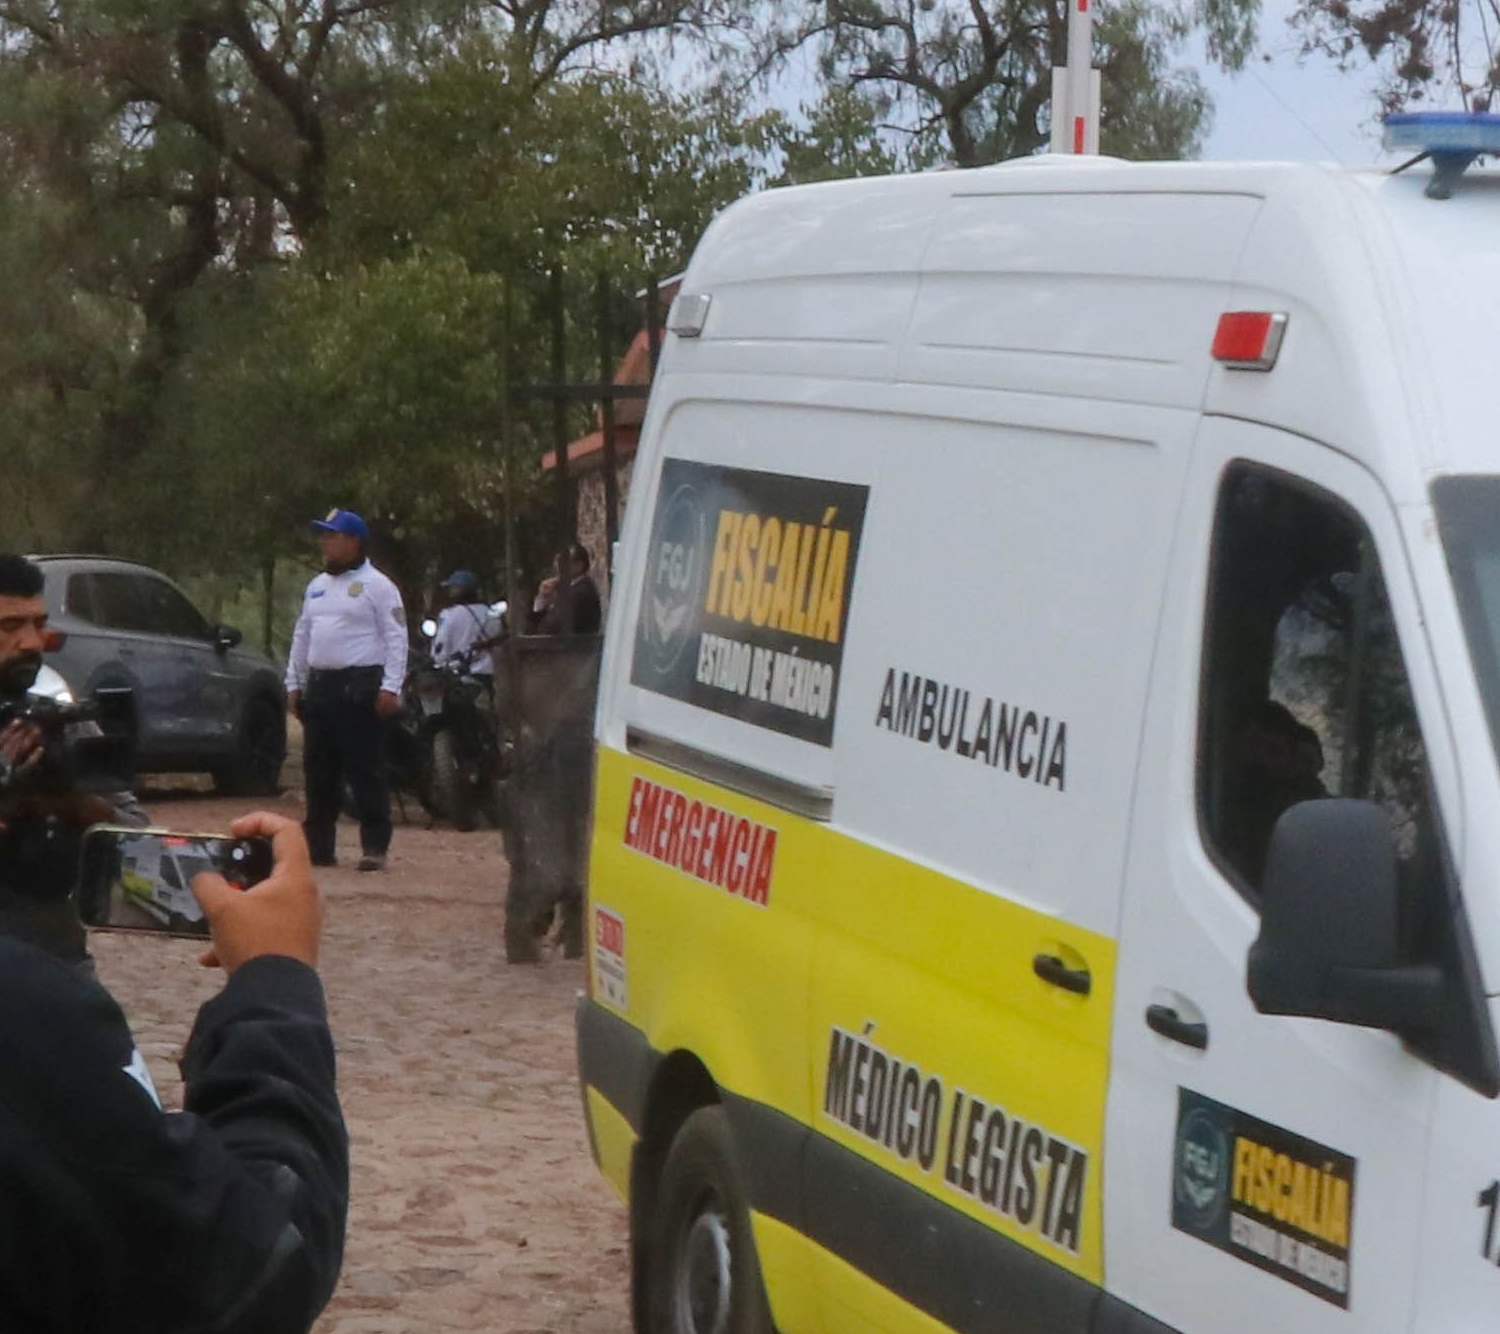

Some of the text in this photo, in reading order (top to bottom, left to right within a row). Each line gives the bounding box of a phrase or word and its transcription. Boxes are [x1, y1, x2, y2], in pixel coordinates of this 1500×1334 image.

[657, 541, 695, 591] FGJ
[705, 506, 850, 643] FISCALÍA
[696, 632, 834, 719] ESTADO DE MÉXICO
[875, 667, 1067, 792] AMBULANCIA
[624, 776, 778, 909] EMERGENCIA
[825, 1020, 1088, 1256] MÉDICO LEGISTA
[1232, 1136, 1349, 1249] FISCALÍA
